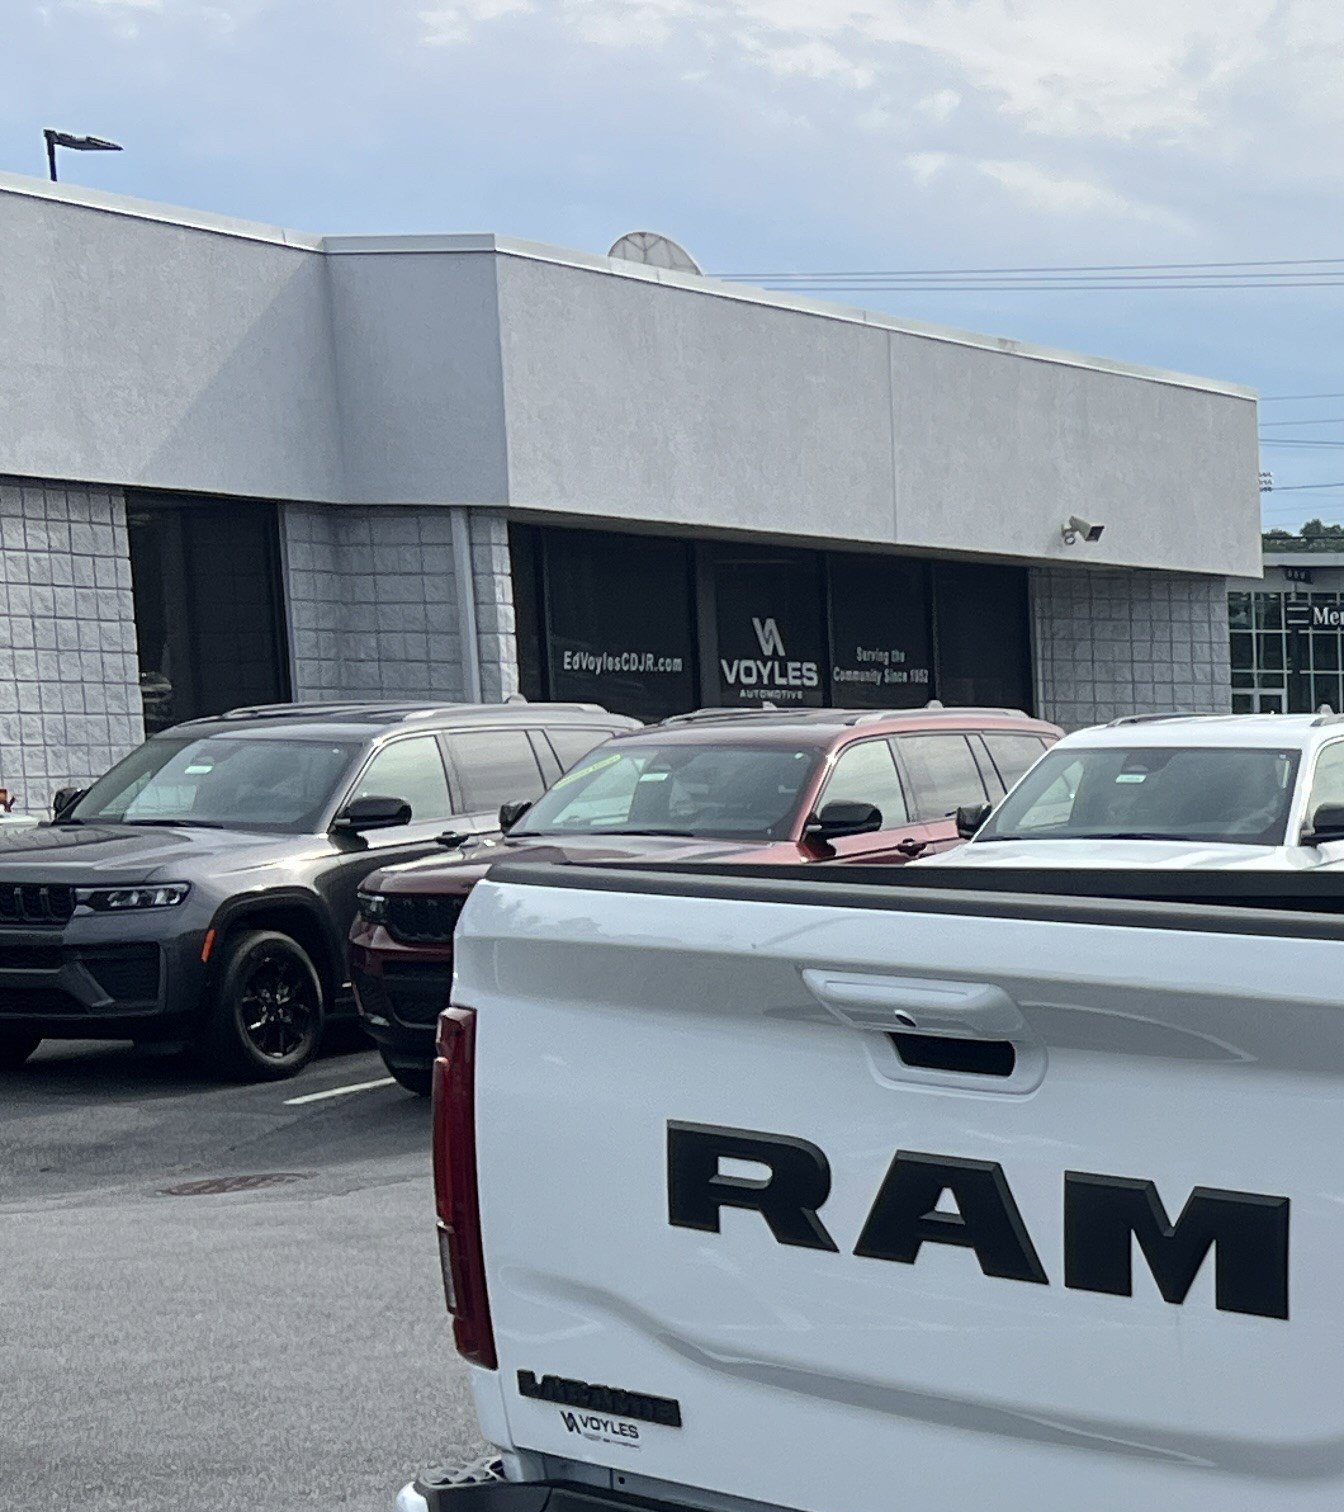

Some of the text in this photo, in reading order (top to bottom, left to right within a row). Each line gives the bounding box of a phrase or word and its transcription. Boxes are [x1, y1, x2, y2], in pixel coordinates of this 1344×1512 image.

[563, 650, 682, 675] EdVoylesCDJR.com
[857, 646, 889, 665] Serving
[721, 659, 819, 687] VOYLES
[833, 666, 882, 686] Community
[740, 689, 803, 699] AUTOMOTIVE
[667, 1119, 1290, 1321] RAM
[579, 1414, 639, 1439] VOYLES
